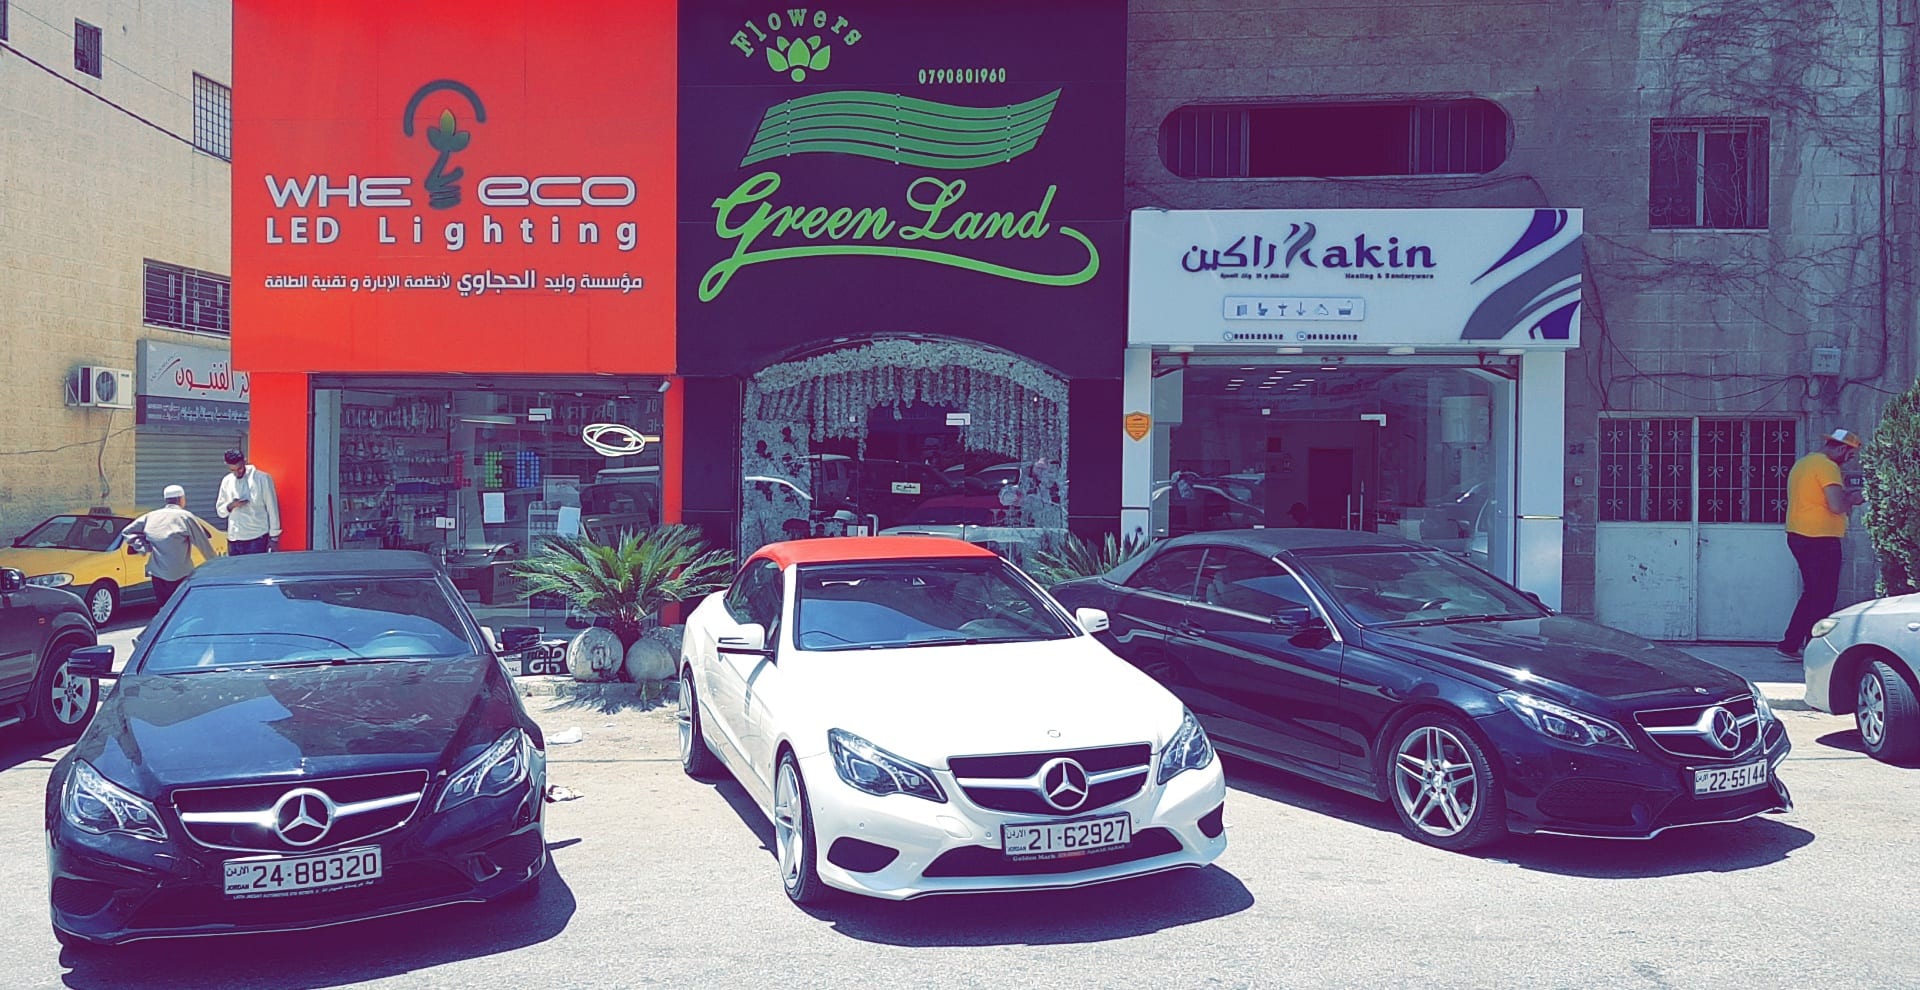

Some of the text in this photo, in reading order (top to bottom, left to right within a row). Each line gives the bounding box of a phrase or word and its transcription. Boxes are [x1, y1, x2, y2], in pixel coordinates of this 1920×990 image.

[730, 8, 862, 58] Flowers
[918, 67, 1006, 84] 0790801960
[266, 215, 638, 250] LED Lighting
[698, 172, 1057, 282] Green Land
[1181, 235, 1278, 273] راكين
[264, 269, 643, 297] مؤسسة وليد الحجاوي لأنظمة الإنارة و تقنية الطاقة
[1710, 764, 1765, 791] 22-55144
[1028, 820, 1126, 851] 21-62927
[252, 852, 377, 889] 24-88320
